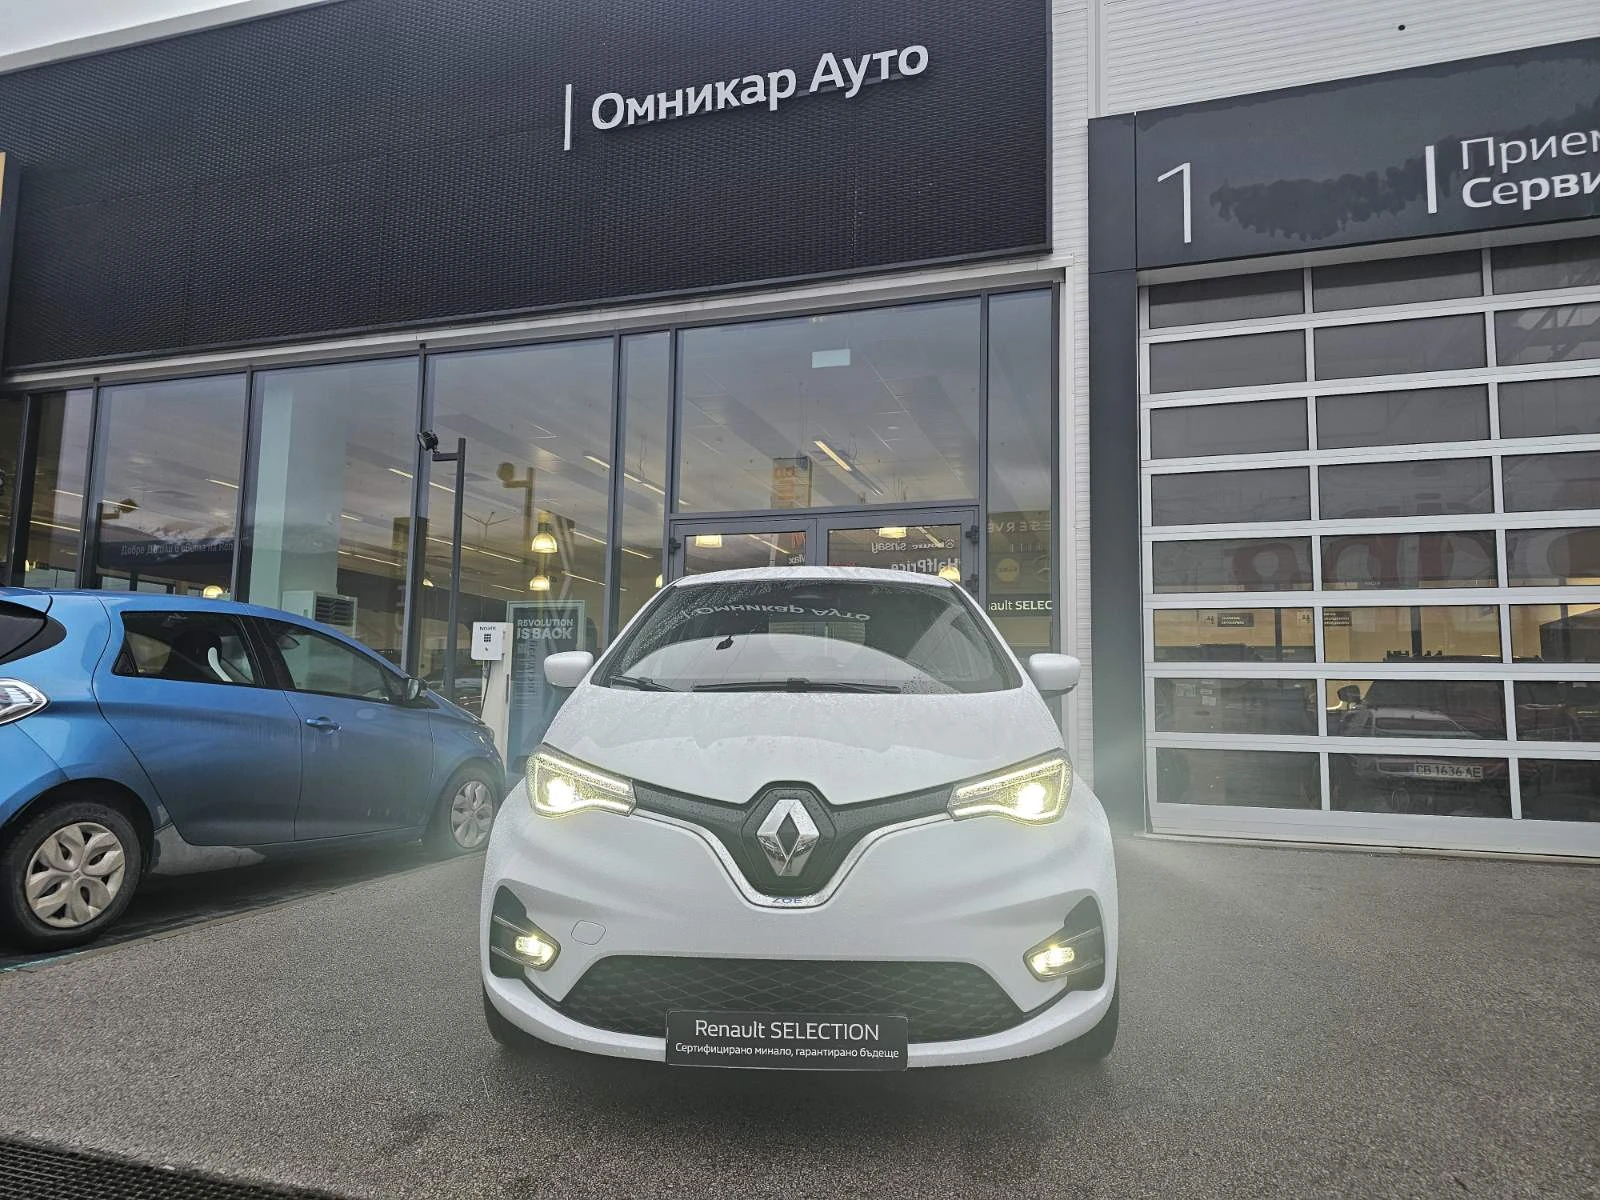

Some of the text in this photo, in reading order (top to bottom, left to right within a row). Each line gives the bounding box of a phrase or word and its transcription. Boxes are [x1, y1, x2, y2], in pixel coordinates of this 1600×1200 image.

[591, 45, 929, 130] Омникар Ауто
[1157, 162, 1192, 243] 1
[989, 600, 1013, 610] ault
[517, 619, 573, 628] REVOLUTION
[517, 627, 573, 640] IS BACK
[695, 1019, 880, 1041] Renault SELECTION
[675, 1042, 899, 1059] Сертифицирано минало, гарантирано бъдеще
